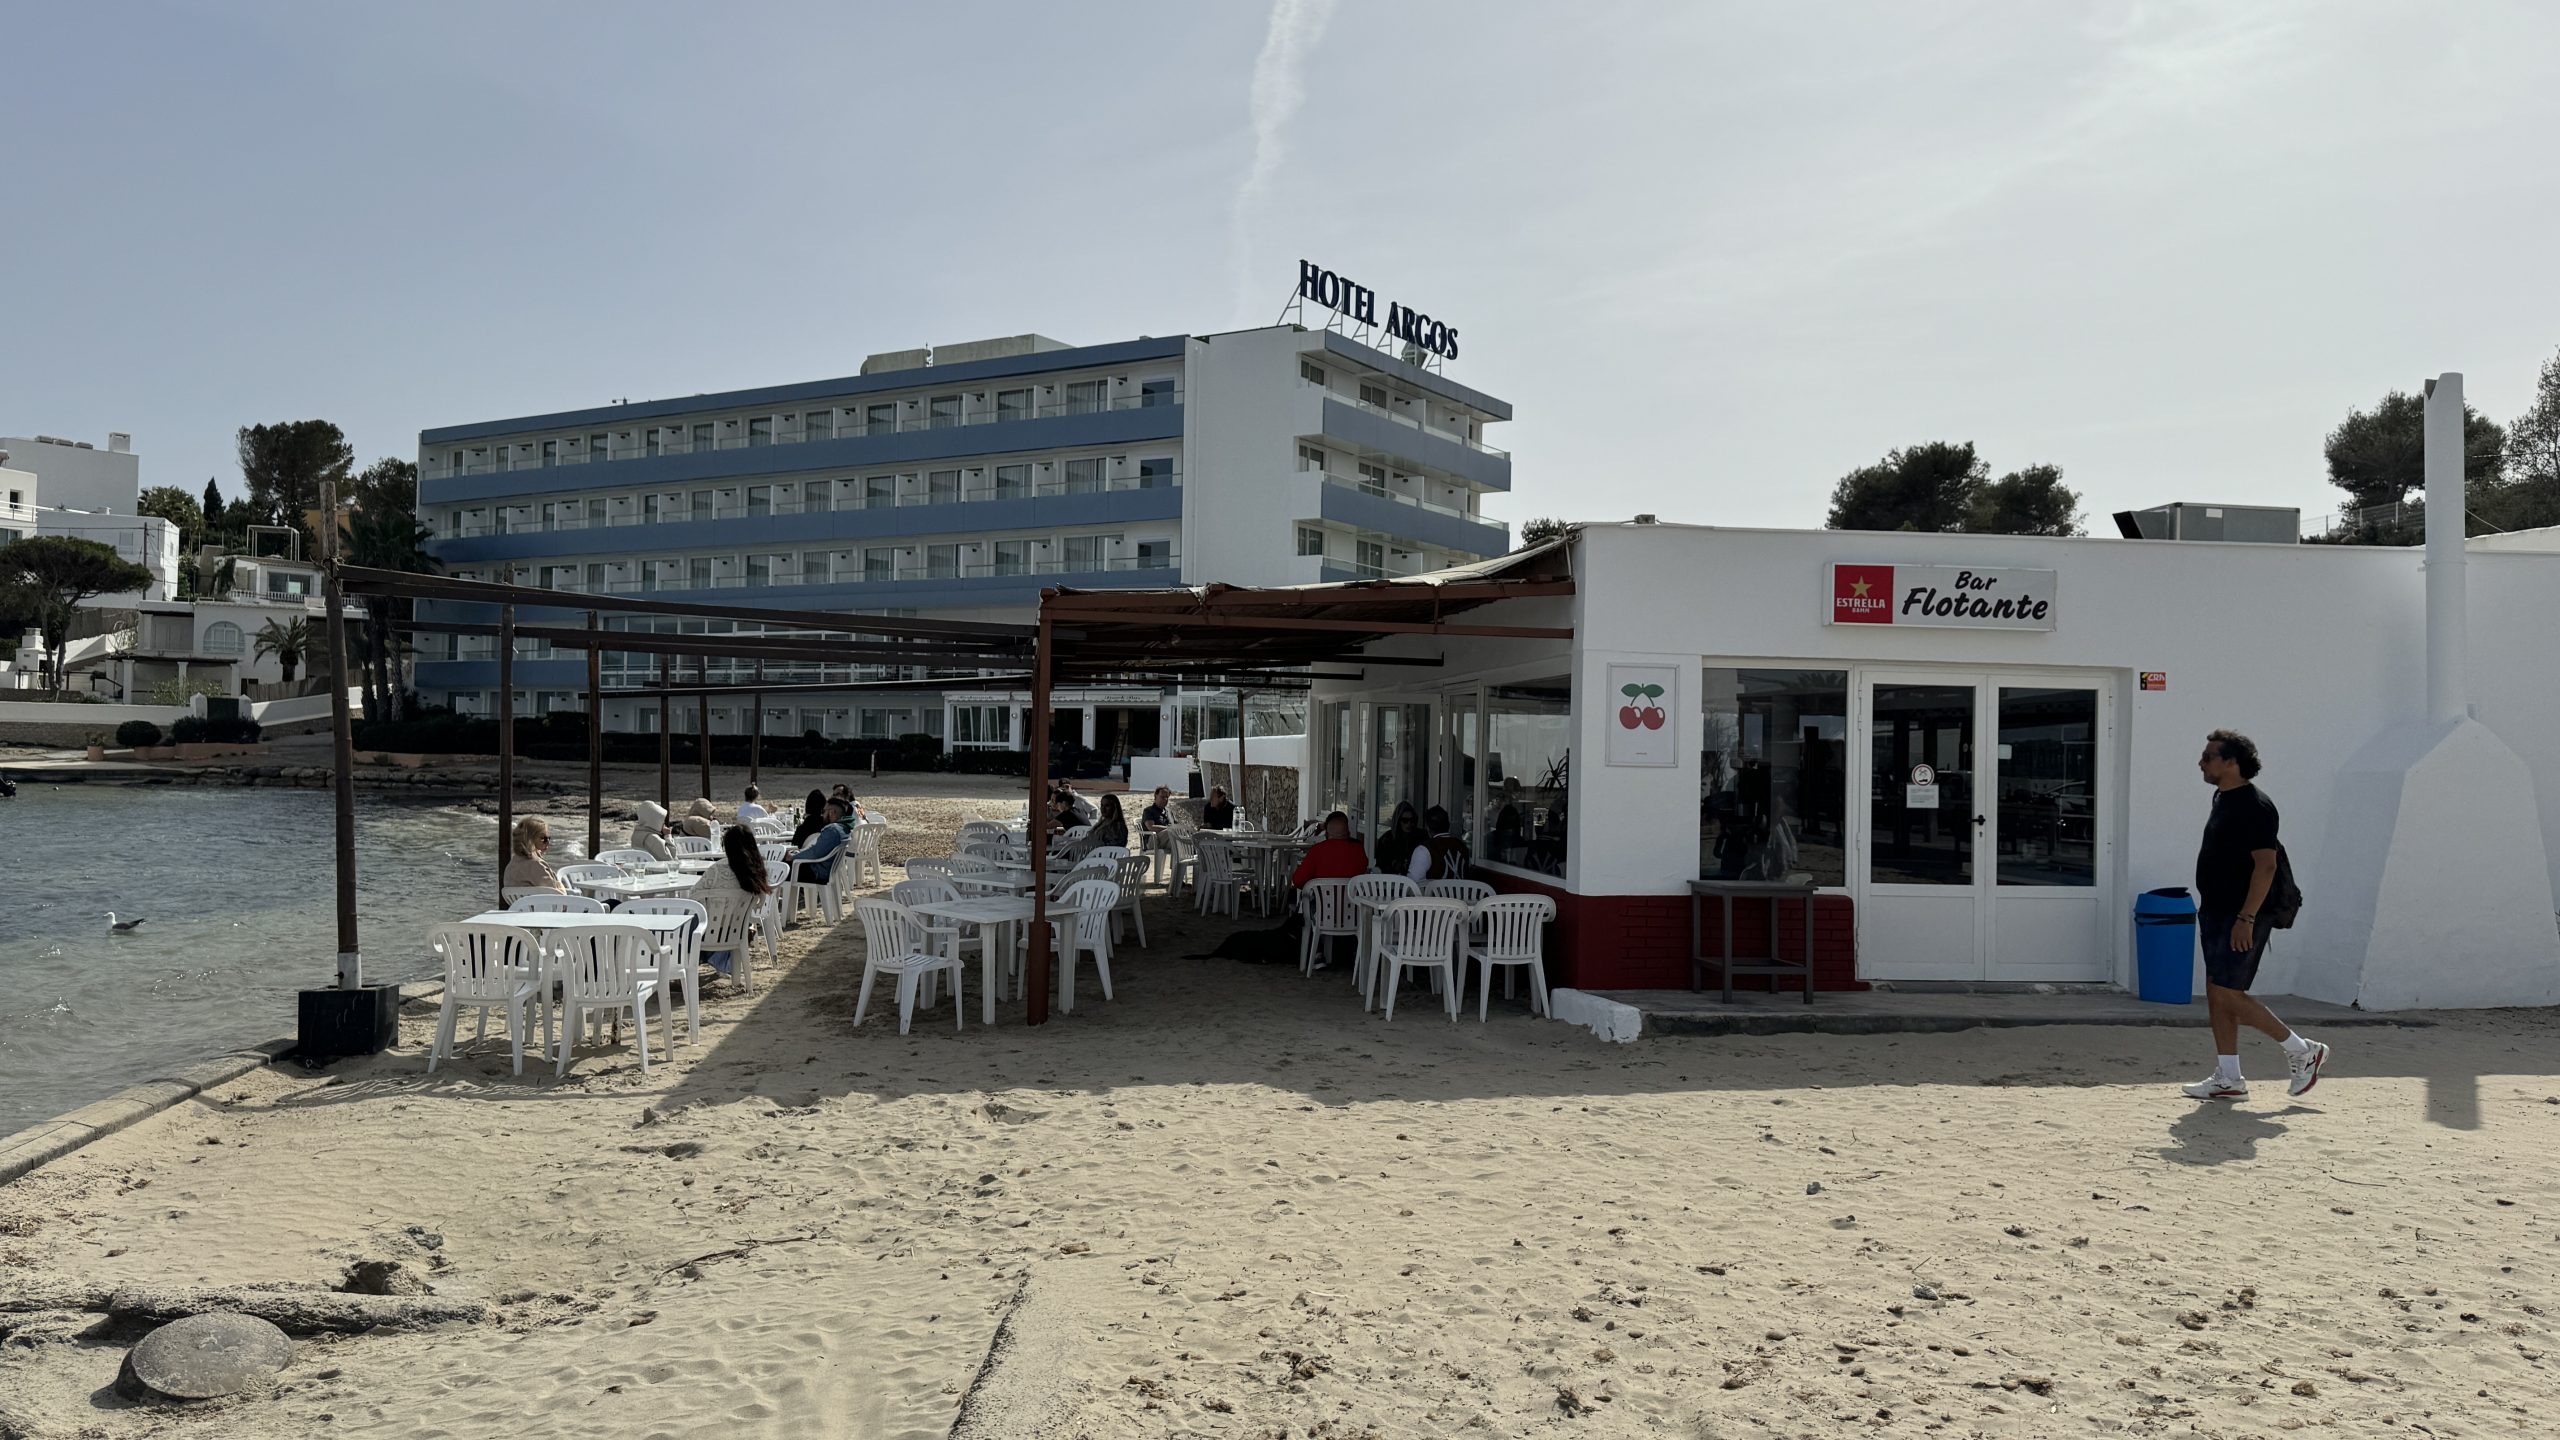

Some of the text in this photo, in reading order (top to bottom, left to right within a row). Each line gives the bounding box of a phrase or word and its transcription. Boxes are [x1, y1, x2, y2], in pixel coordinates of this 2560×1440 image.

[1299, 259, 1459, 360] HOTEL ARGOS
[1954, 570, 1998, 591] Bar
[1836, 597, 1886, 609] ESTRELLA
[1901, 587, 2049, 620] Flotante
